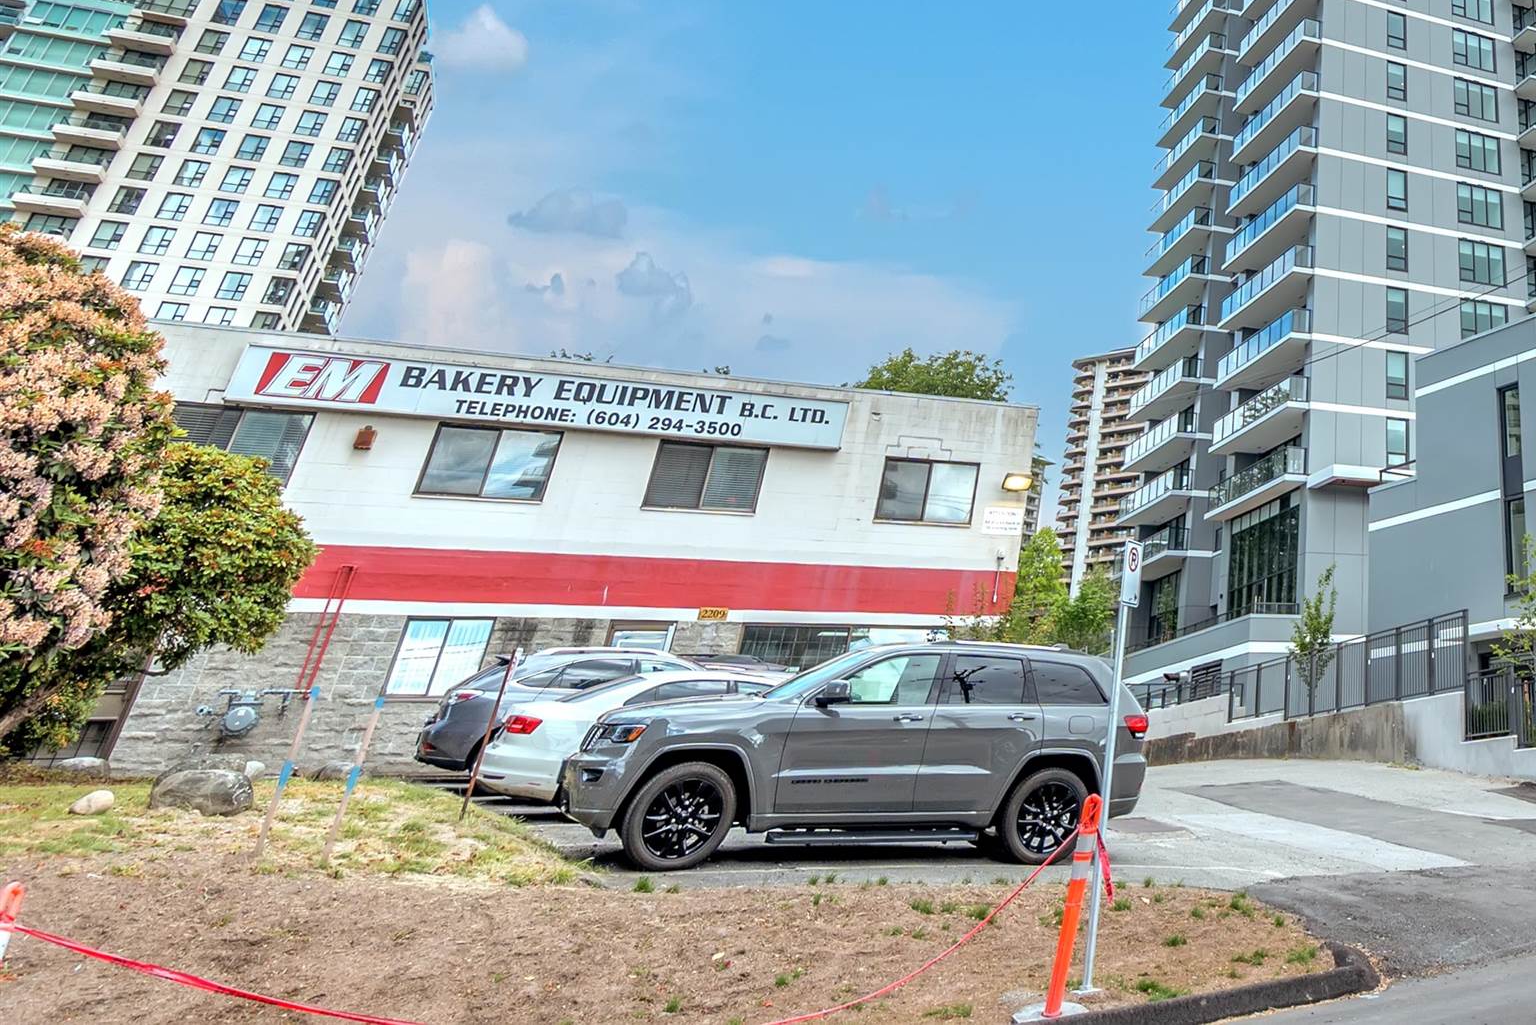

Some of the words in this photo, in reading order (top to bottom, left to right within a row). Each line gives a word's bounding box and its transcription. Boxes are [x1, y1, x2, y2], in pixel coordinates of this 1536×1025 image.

[259, 354, 385, 403] EM
[400, 366, 543, 398] BAKERY
[553, 380, 732, 414] EQUIPMENT
[739, 401, 778, 420] B.C.
[788, 406, 830, 425] LTD.
[455, 399, 576, 423] TELEPHONE:
[586, 408, 640, 429] (604)
[647, 416, 741, 437] 294-3500
[702, 609, 726, 619] 2209
